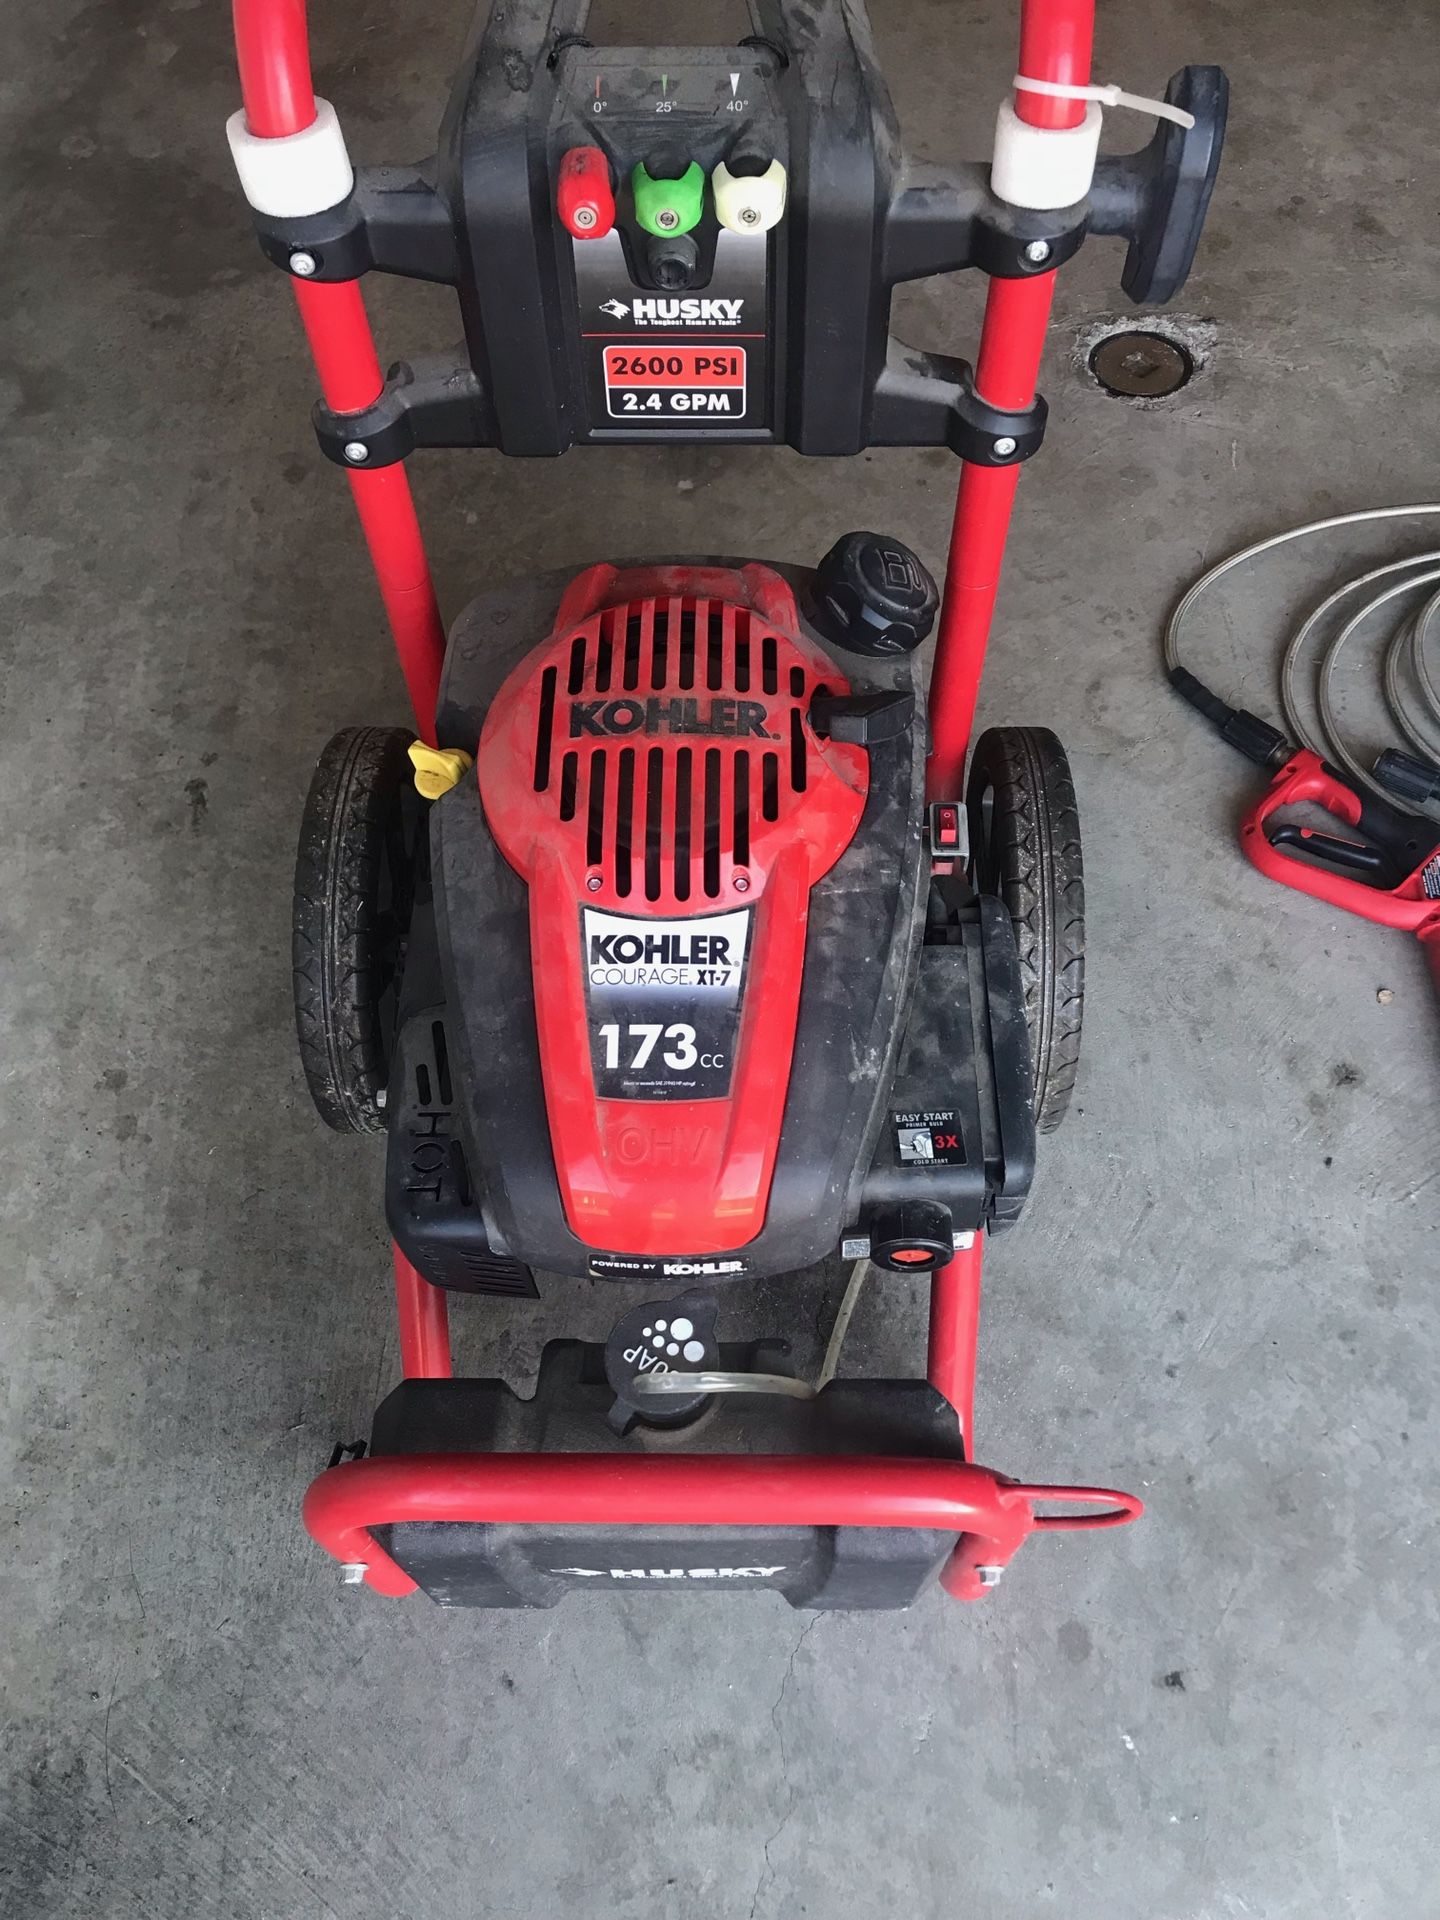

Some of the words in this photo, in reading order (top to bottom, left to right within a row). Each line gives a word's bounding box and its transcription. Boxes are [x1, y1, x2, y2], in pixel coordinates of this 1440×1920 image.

[632, 298, 744, 319] HUSKY
[611, 356, 683, 376] 2600
[694, 357, 737, 376] PSI
[622, 393, 662, 411] 2.4
[670, 393, 731, 411] GPM
[570, 697, 771, 739] KOHLER
[590, 934, 732, 965] KOHLER
[590, 968, 688, 985] COURAGE
[697, 969, 731, 986] XT-7
[598, 1023, 698, 1070] 173
[895, 1114, 920, 1123] EASY
[923, 1112, 954, 1121] START
[934, 1135, 958, 1149] 3X
[406, 1112, 451, 1203] HOT
[592, 1260, 640, 1269] POWERED
[663, 1261, 744, 1275] KOHLER
[610, 1566, 787, 1578] HUSKY
